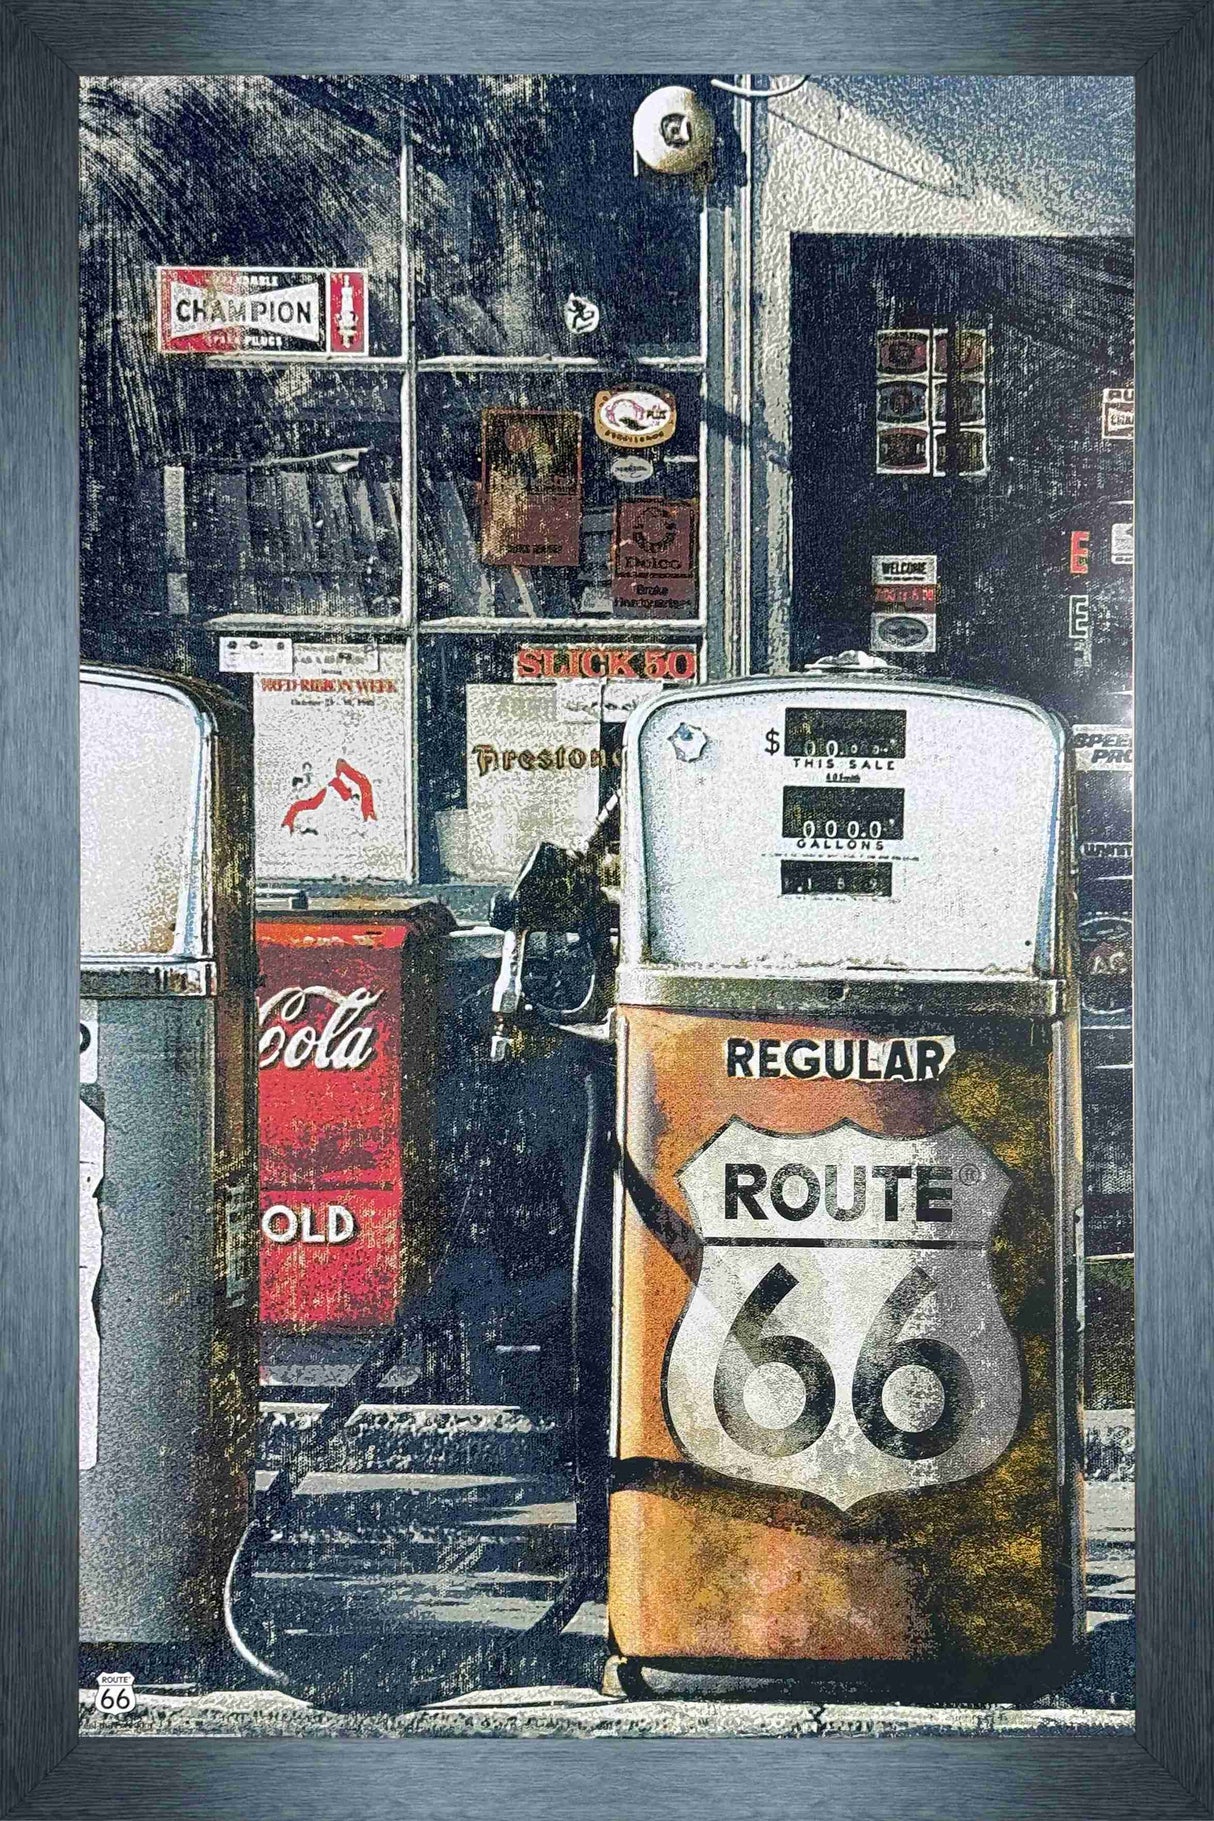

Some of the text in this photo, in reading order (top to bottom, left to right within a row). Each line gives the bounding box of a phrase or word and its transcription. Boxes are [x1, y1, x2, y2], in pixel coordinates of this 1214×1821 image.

[176, 300, 311, 324] CHAMPION
[882, 562, 927, 574] WELCOME
[518, 649, 696, 679] SLICK 50
[765, 727, 780, 756] $
[1074, 733, 1132, 748] SPEE
[793, 758, 895, 771] THIS SALE
[796, 838, 884, 851] GALLONS
[258, 985, 384, 1070] Cola
[727, 1038, 945, 1081] REGULAR
[724, 1163, 953, 1222] ROUTE
[713, 1262, 975, 1461] 66
